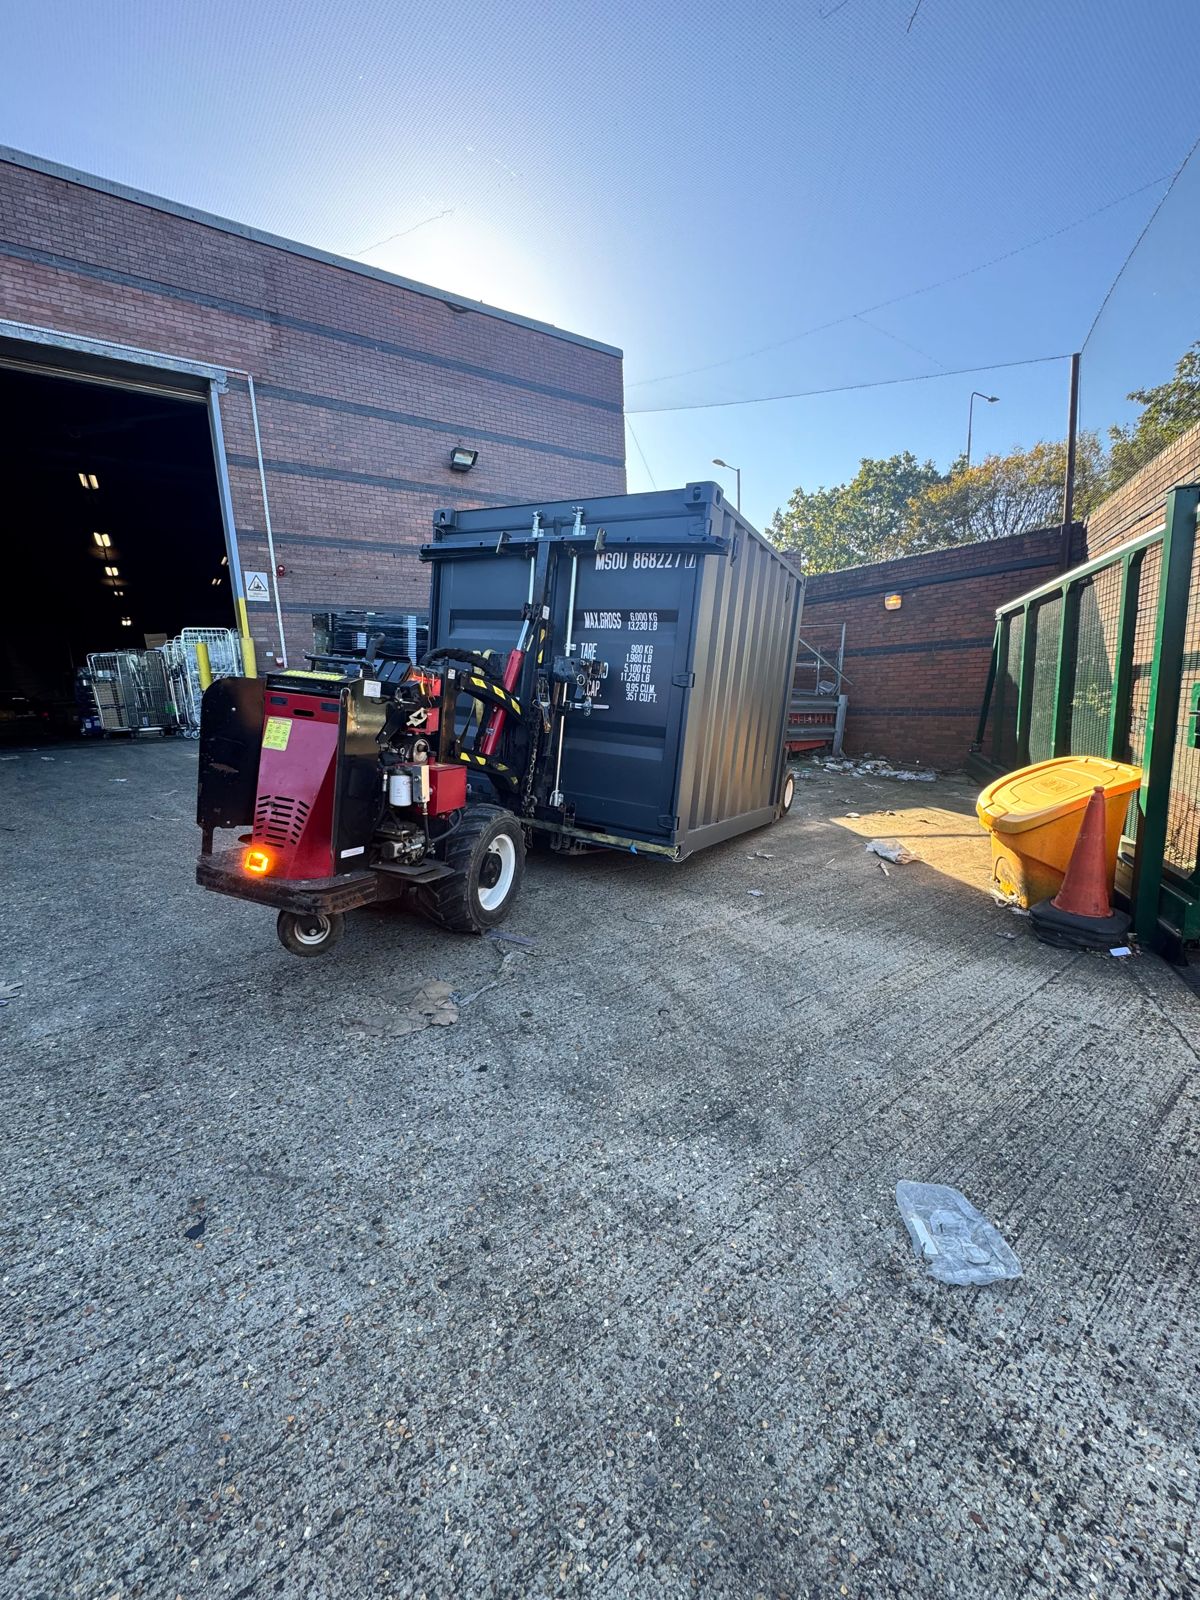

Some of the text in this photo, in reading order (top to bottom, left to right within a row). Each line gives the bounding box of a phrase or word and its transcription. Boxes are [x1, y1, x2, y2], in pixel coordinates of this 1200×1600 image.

[595, 552, 628, 570] MSOU
[632, 552, 681, 569] 868227
[584, 612, 658, 629] MAX.GROSS 6.000 KG
[628, 621, 658, 631] 13.230 LB
[580, 642, 654, 660] TARE 900 KG
[626, 653, 653, 664] 1.980 LB
[623, 663, 652, 674] 5.100 KG
[641, 673, 651, 683] LB
[625, 691, 637, 701] 351
